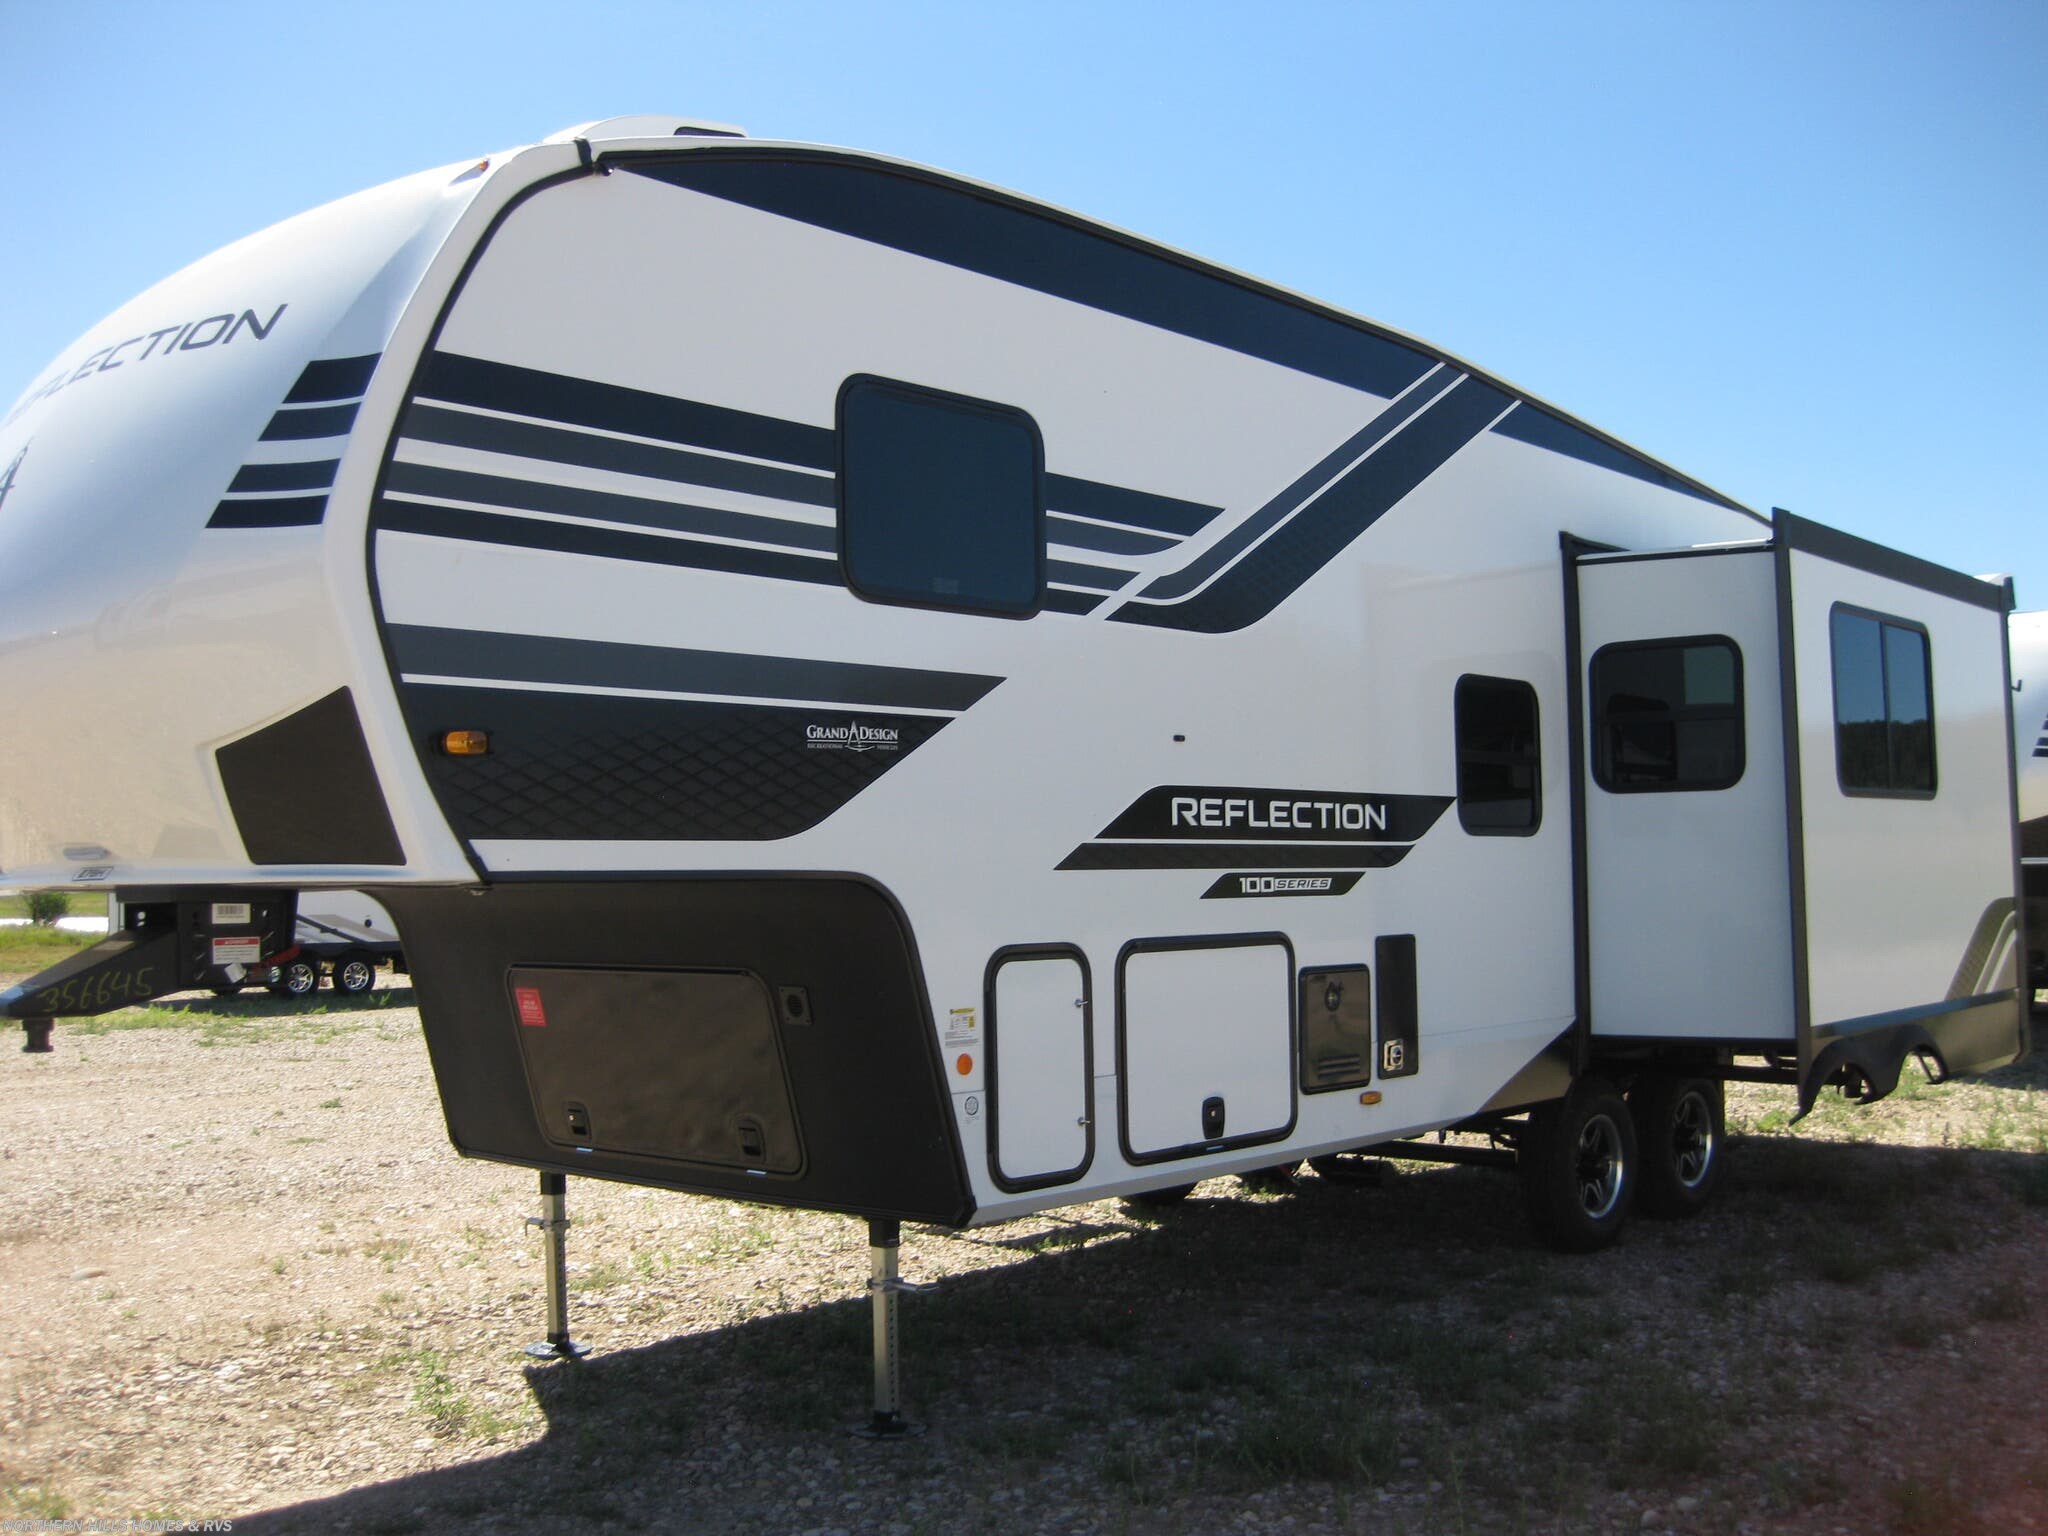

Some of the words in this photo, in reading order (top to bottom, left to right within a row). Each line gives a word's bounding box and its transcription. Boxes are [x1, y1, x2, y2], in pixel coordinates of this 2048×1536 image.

[806, 724, 849, 739] GRAND
[859, 726, 899, 741] DESIGN
[1171, 797, 1387, 831] REFLECTION
[1239, 876, 1275, 894] 100
[1275, 877, 1331, 890] SERIES
